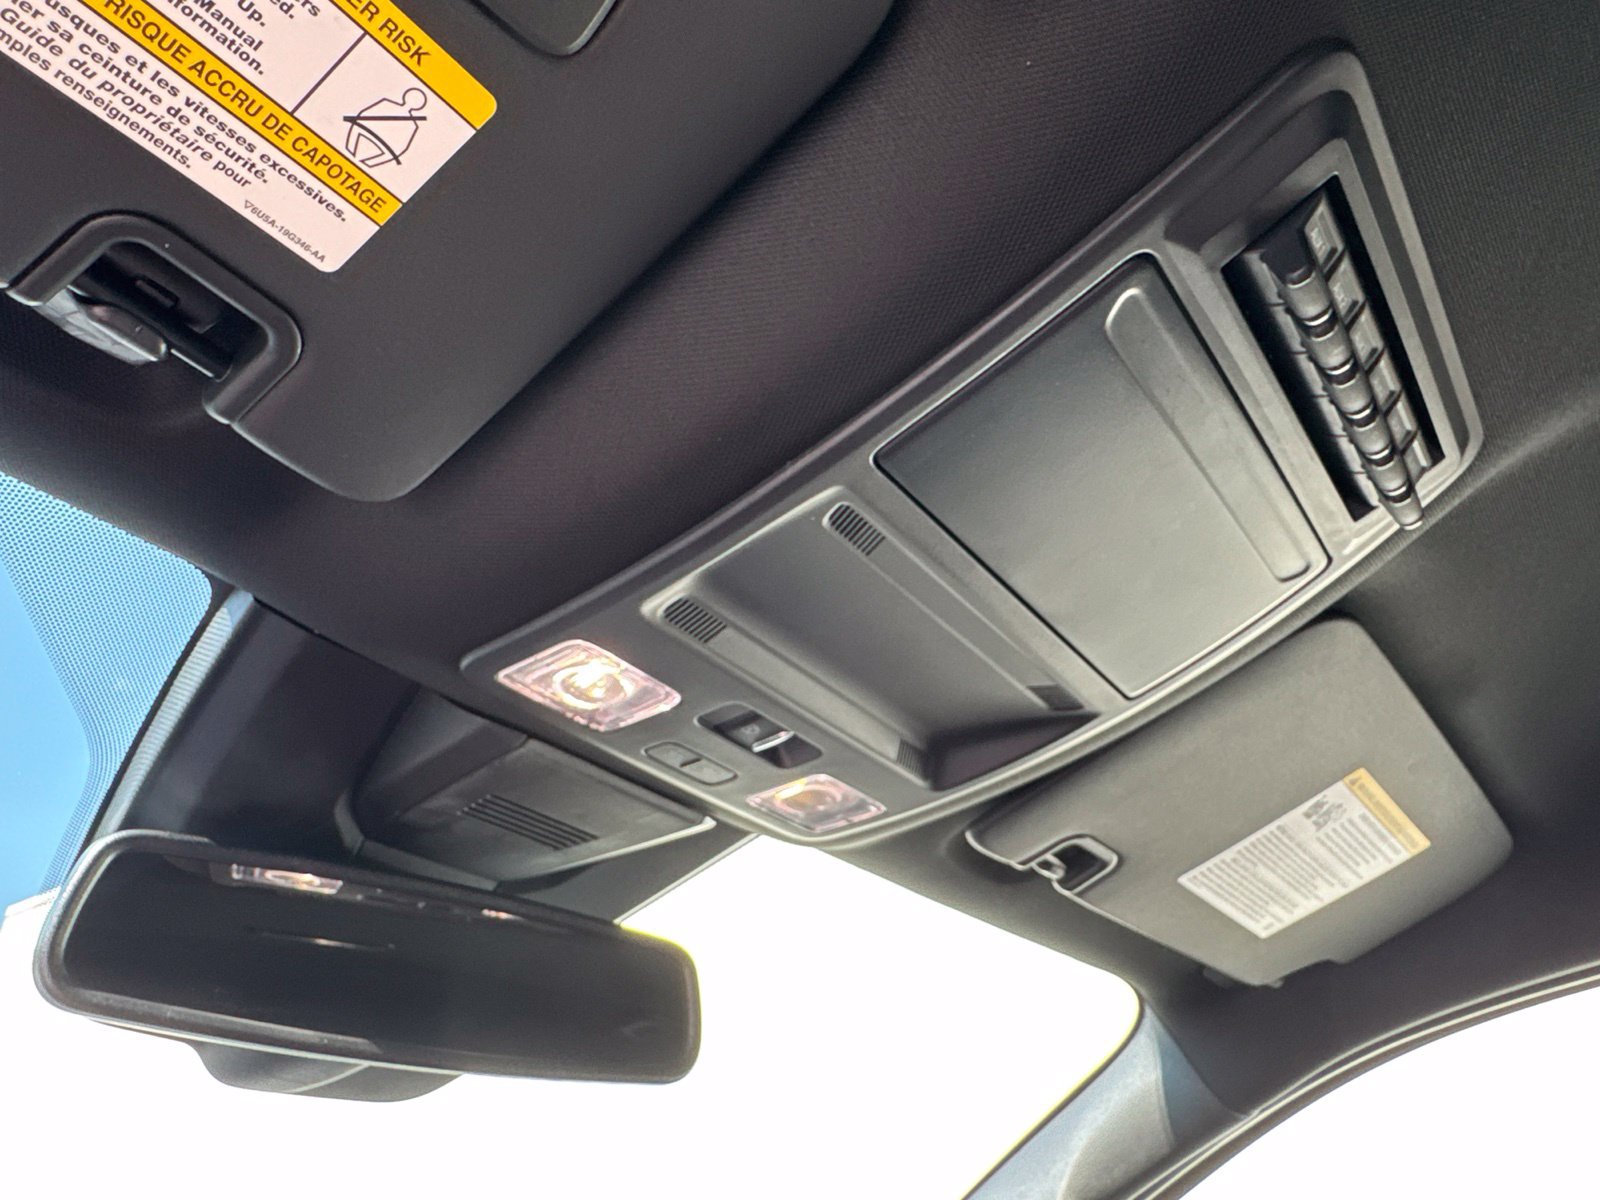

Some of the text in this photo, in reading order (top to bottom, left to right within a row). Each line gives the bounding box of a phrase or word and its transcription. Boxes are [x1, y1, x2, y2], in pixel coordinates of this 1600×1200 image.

[237, 0, 266, 27] Up.
[378, 18, 431, 66] RISK
[0, 8, 252, 188] Guide du propriétaire pour
[47, 21, 74, 43] sa
[78, 43, 163, 106] ceinture
[166, 104, 191, 126] de
[193, 123, 268, 184] sécurité.
[54, 69, 192, 169] renseignements.
[104, 0, 387, 213] RISQUE ACCRU DE CAPOTAGE
[125, 55, 148, 74] et
[150, 70, 181, 97] les
[184, 96, 258, 153] vitesses
[259, 153, 347, 222] excessives.
